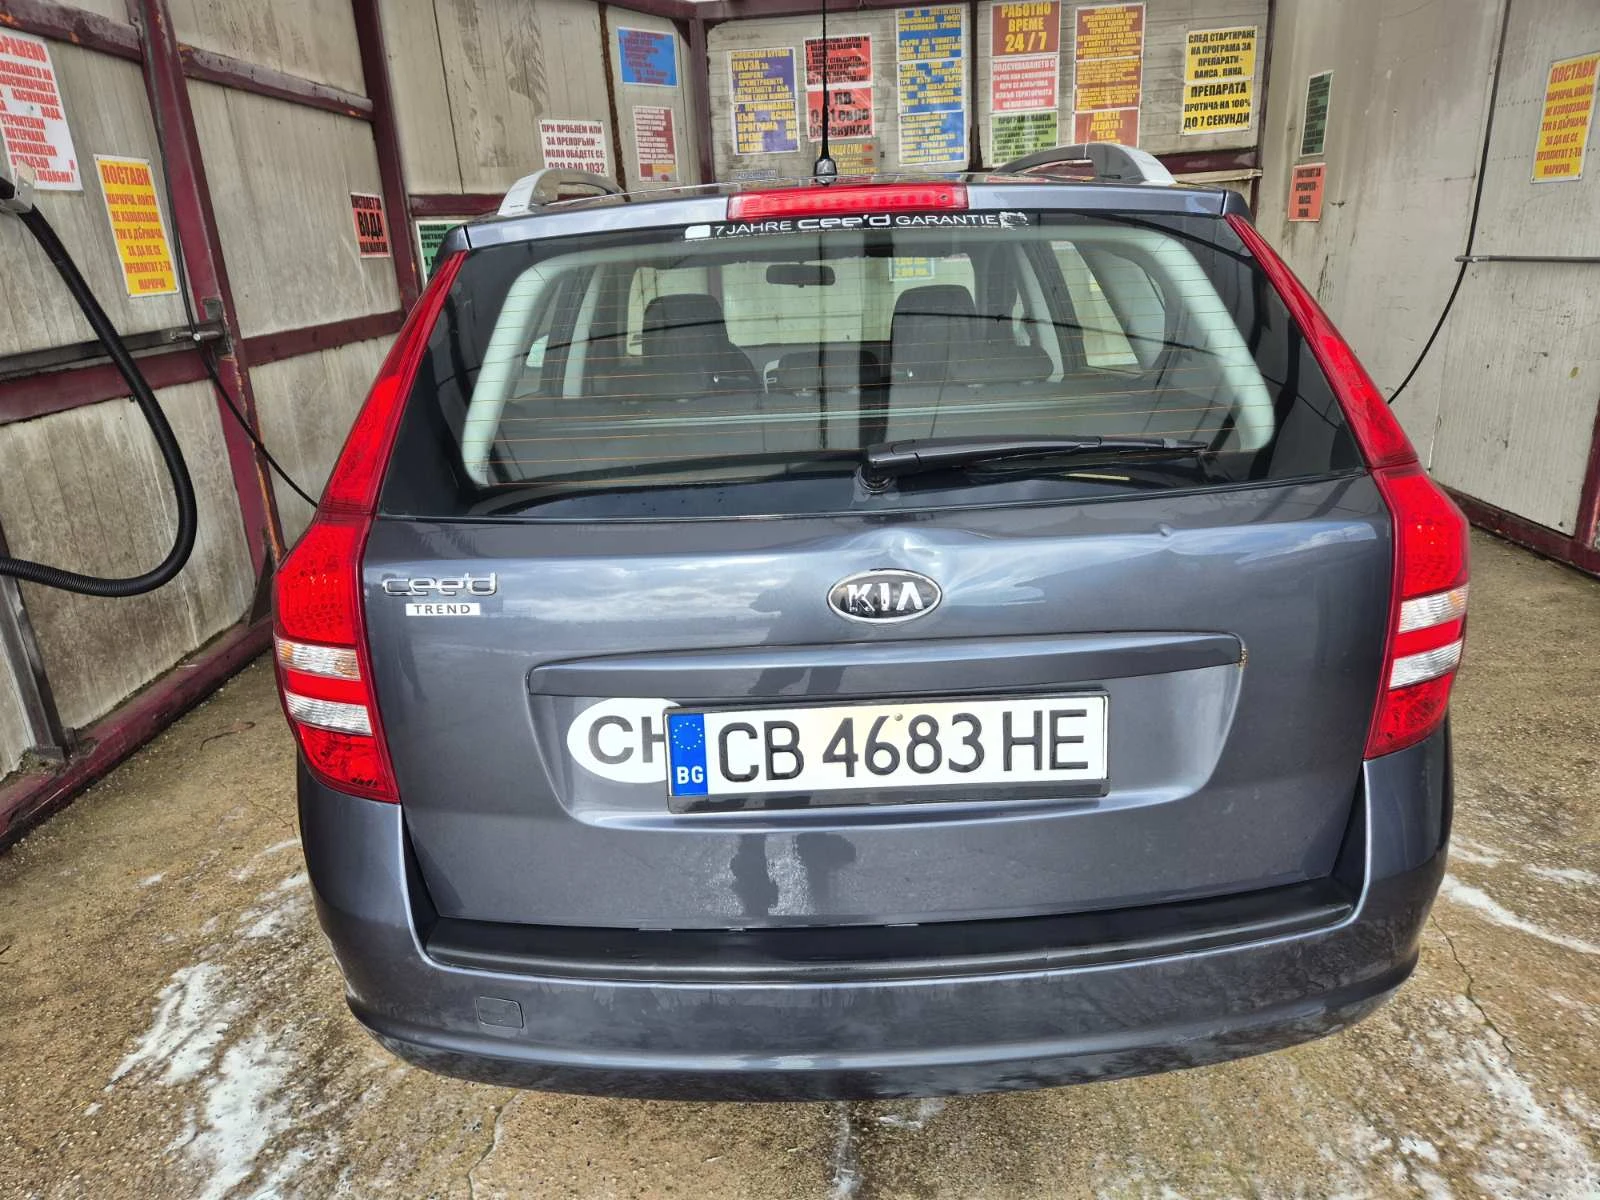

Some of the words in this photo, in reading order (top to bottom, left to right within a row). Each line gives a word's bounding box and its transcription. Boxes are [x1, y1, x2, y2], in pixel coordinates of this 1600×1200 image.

[1001, 2, 1051, 18] РАБОТНО
[1009, 17, 1044, 32] ВРЕМЕ
[1189, 34, 1209, 44] СЛЕД
[1210, 30, 1255, 41] СТАРТИРАНЕ
[1191, 46, 1201, 55] НА
[1202, 43, 1240, 54] ПРОГРАМА
[1241, 42, 1251, 51] ЗА
[732, 60, 759, 72] ПАУЗА
[1198, 55, 1239, 67] ПРЕПАРАТИ
[1551, 60, 1597, 83] ПОСТАВИ
[1191, 82, 1246, 98] ПРЕПАРАТА
[1185, 101, 1218, 113] ПРОТИЧА
[1220, 100, 1229, 109] НА
[1232, 98, 1251, 108] 100%
[1184, 116, 1198, 130] ДО
[1199, 115, 1205, 127] 7
[1207, 112, 1250, 126] СЕКУНДИ
[541, 124, 556, 133] ПРИ
[557, 125, 588, 134] ПРОБЛЕМ
[589, 126, 602, 134] ИЛИ
[546, 137, 556, 146] ЗА
[556, 137, 595, 146] ПРЕПОРЪКИ
[545, 149, 565, 158] МОЛЯ
[565, 150, 594, 159] ОБАДЕТЕ
[595, 151, 604, 159] СЕ
[101, 165, 151, 186] ПОСТАВИ
[585, 163, 605, 173] 1032
[357, 211, 383, 240] ВОДА
[714, 225, 722, 236] 7
[725, 220, 792, 235] JAHRE
[895, 214, 999, 225] GARANTIE
[846, 582, 924, 612] KIA
[413, 604, 471, 615] TREND
[718, 720, 804, 783] CB
[822, 712, 985, 777] 4683
[1003, 709, 1089, 771] HE
[676, 766, 704, 784] BG
